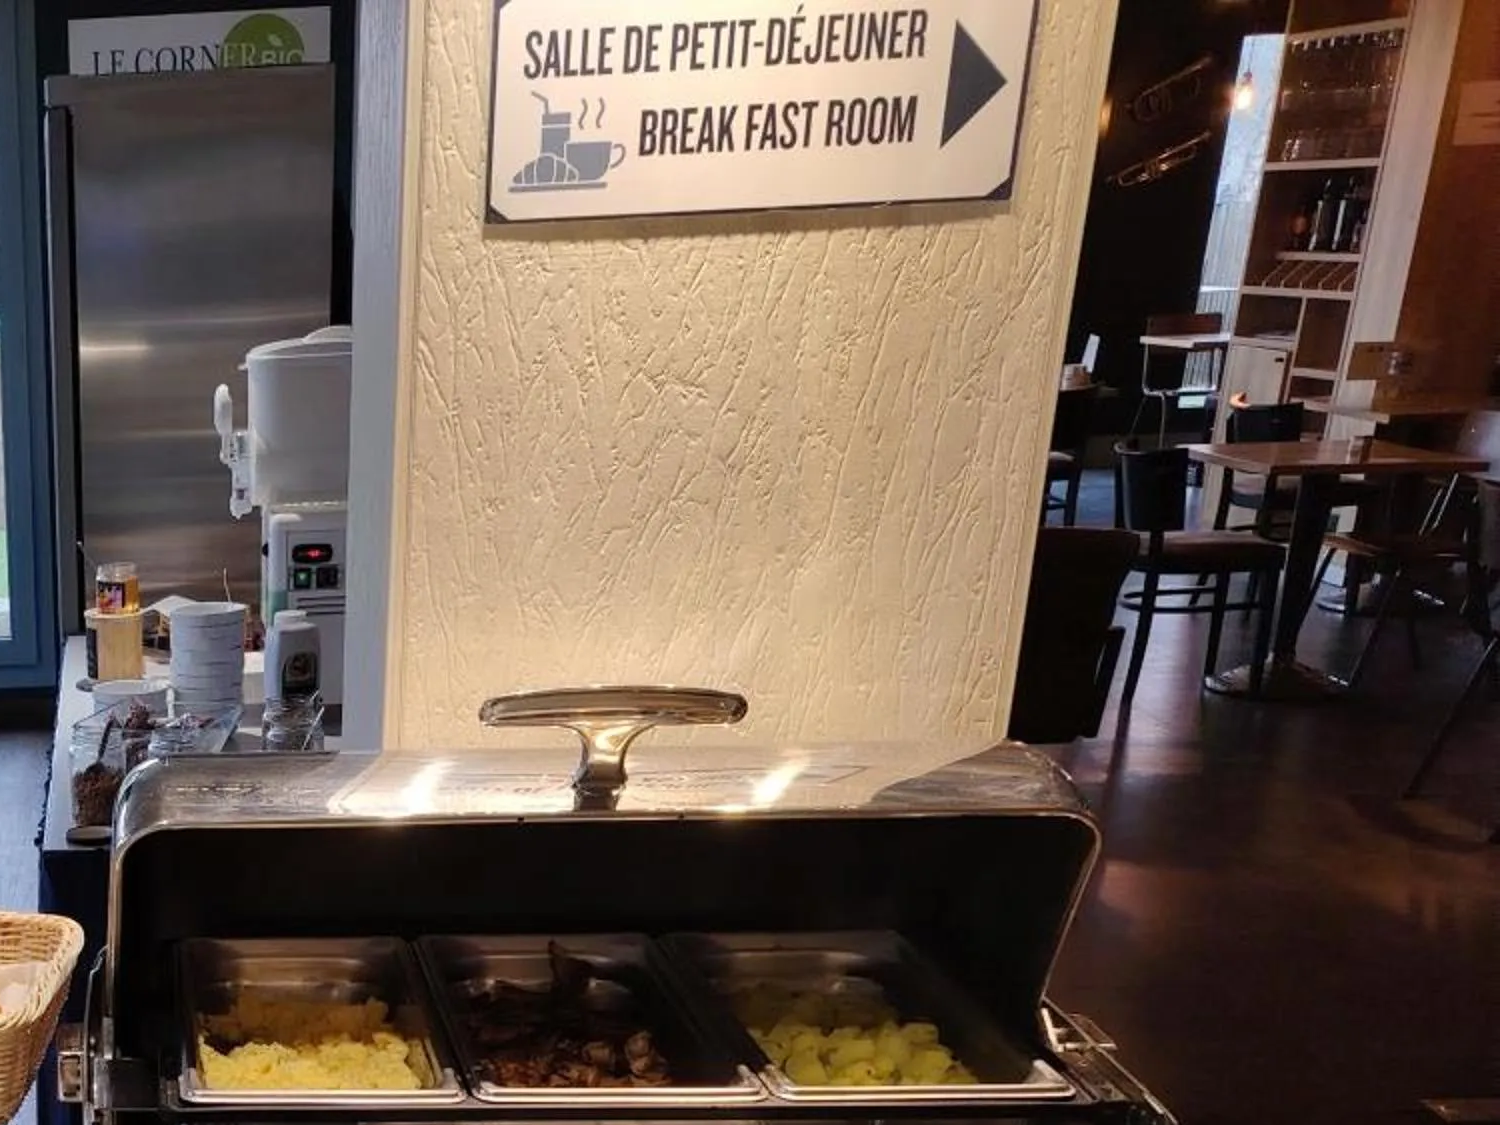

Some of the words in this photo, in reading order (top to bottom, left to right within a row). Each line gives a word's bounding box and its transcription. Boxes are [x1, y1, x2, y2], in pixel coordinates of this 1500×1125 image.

[93, 50, 125, 76] LE
[135, 41, 255, 75] CORNER
[260, 50, 303, 66] BIO
[523, 27, 616, 79] SALLE
[623, 23, 661, 74] DE
[669, 4, 929, 72] PETIT-DÉJEUNER
[638, 104, 735, 157] BREAK
[743, 100, 819, 152] FAST
[825, 95, 918, 149] ROOM
